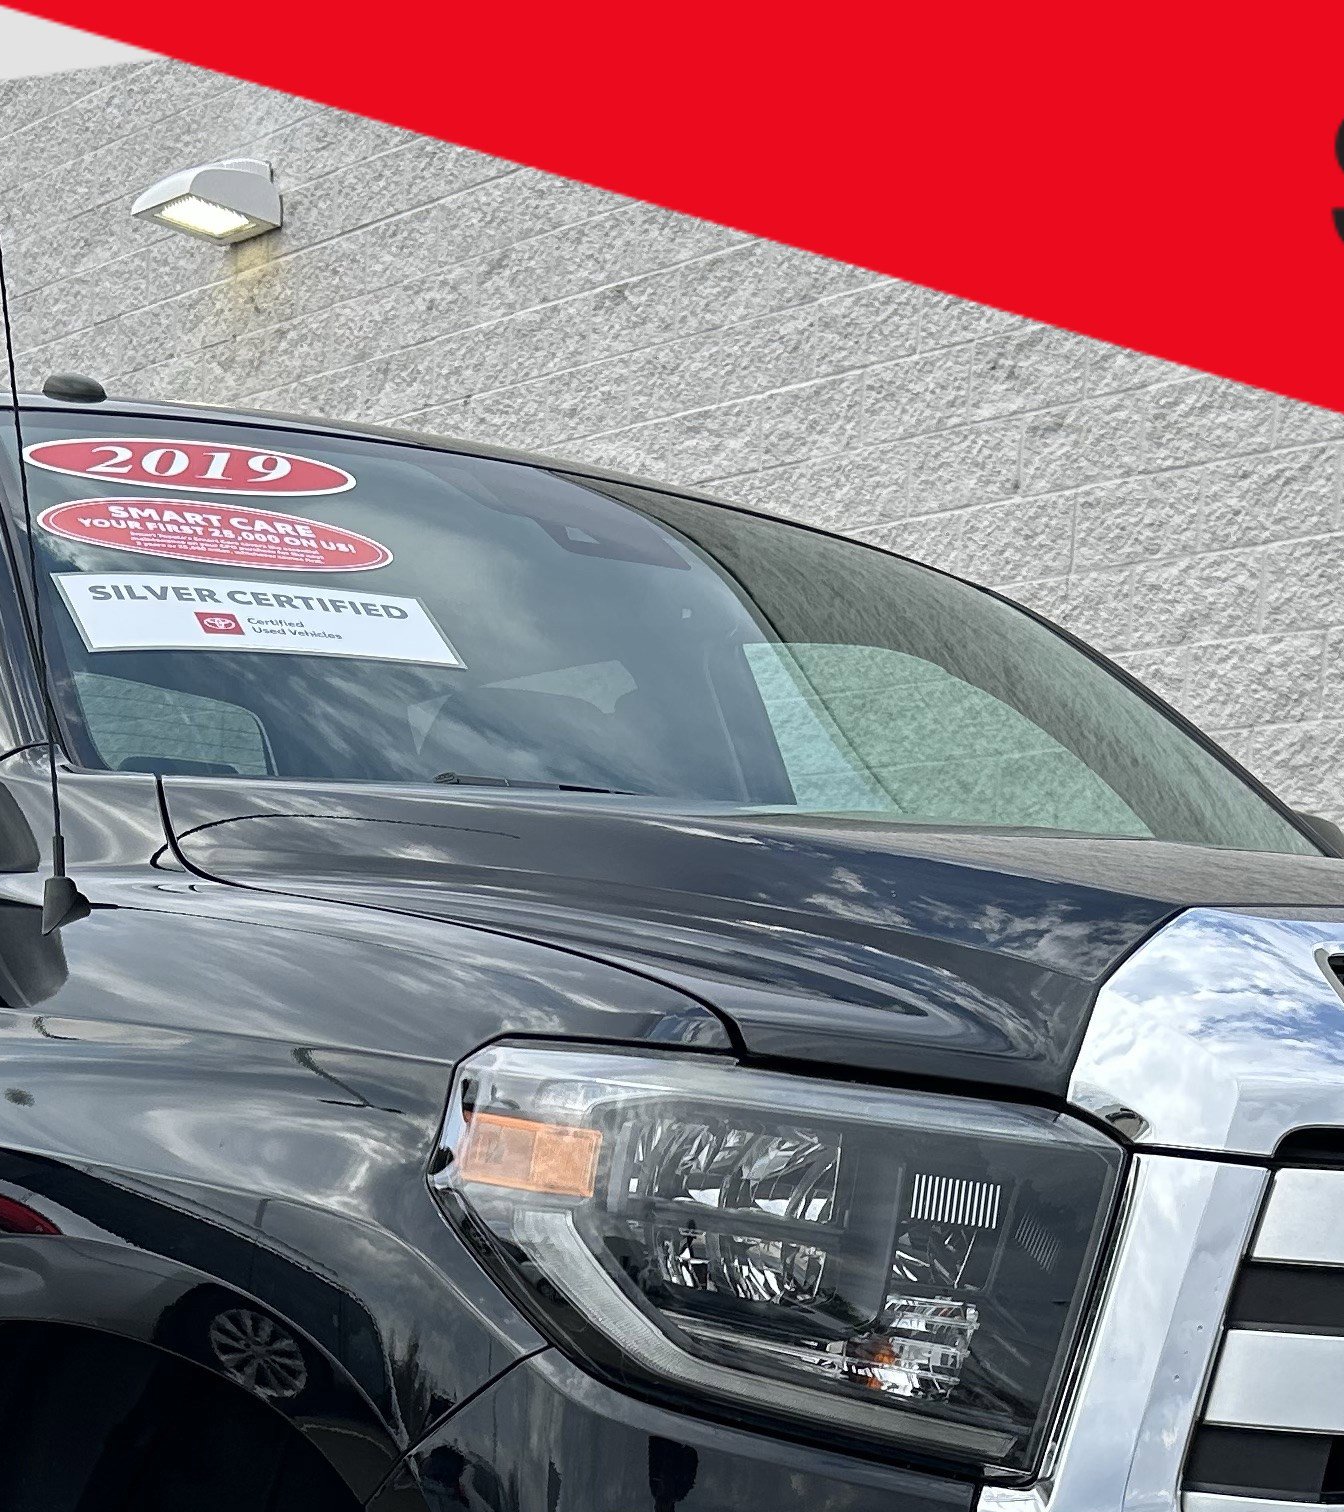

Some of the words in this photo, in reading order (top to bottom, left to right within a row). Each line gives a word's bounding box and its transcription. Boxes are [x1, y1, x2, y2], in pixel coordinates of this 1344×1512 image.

[85, 445, 293, 484] 2019
[76, 517, 144, 531] YOUR
[145, 521, 204, 536] FIRST
[283, 536, 319, 549] ON
[107, 504, 222, 529] SMART
[229, 517, 317, 539] CARE
[87, 584, 222, 604] SILVER
[226, 590, 409, 621] CERTIFIED
[246, 617, 305, 628] Certified
[251, 626, 287, 636] Used
[287, 629, 343, 640] Vehicles
